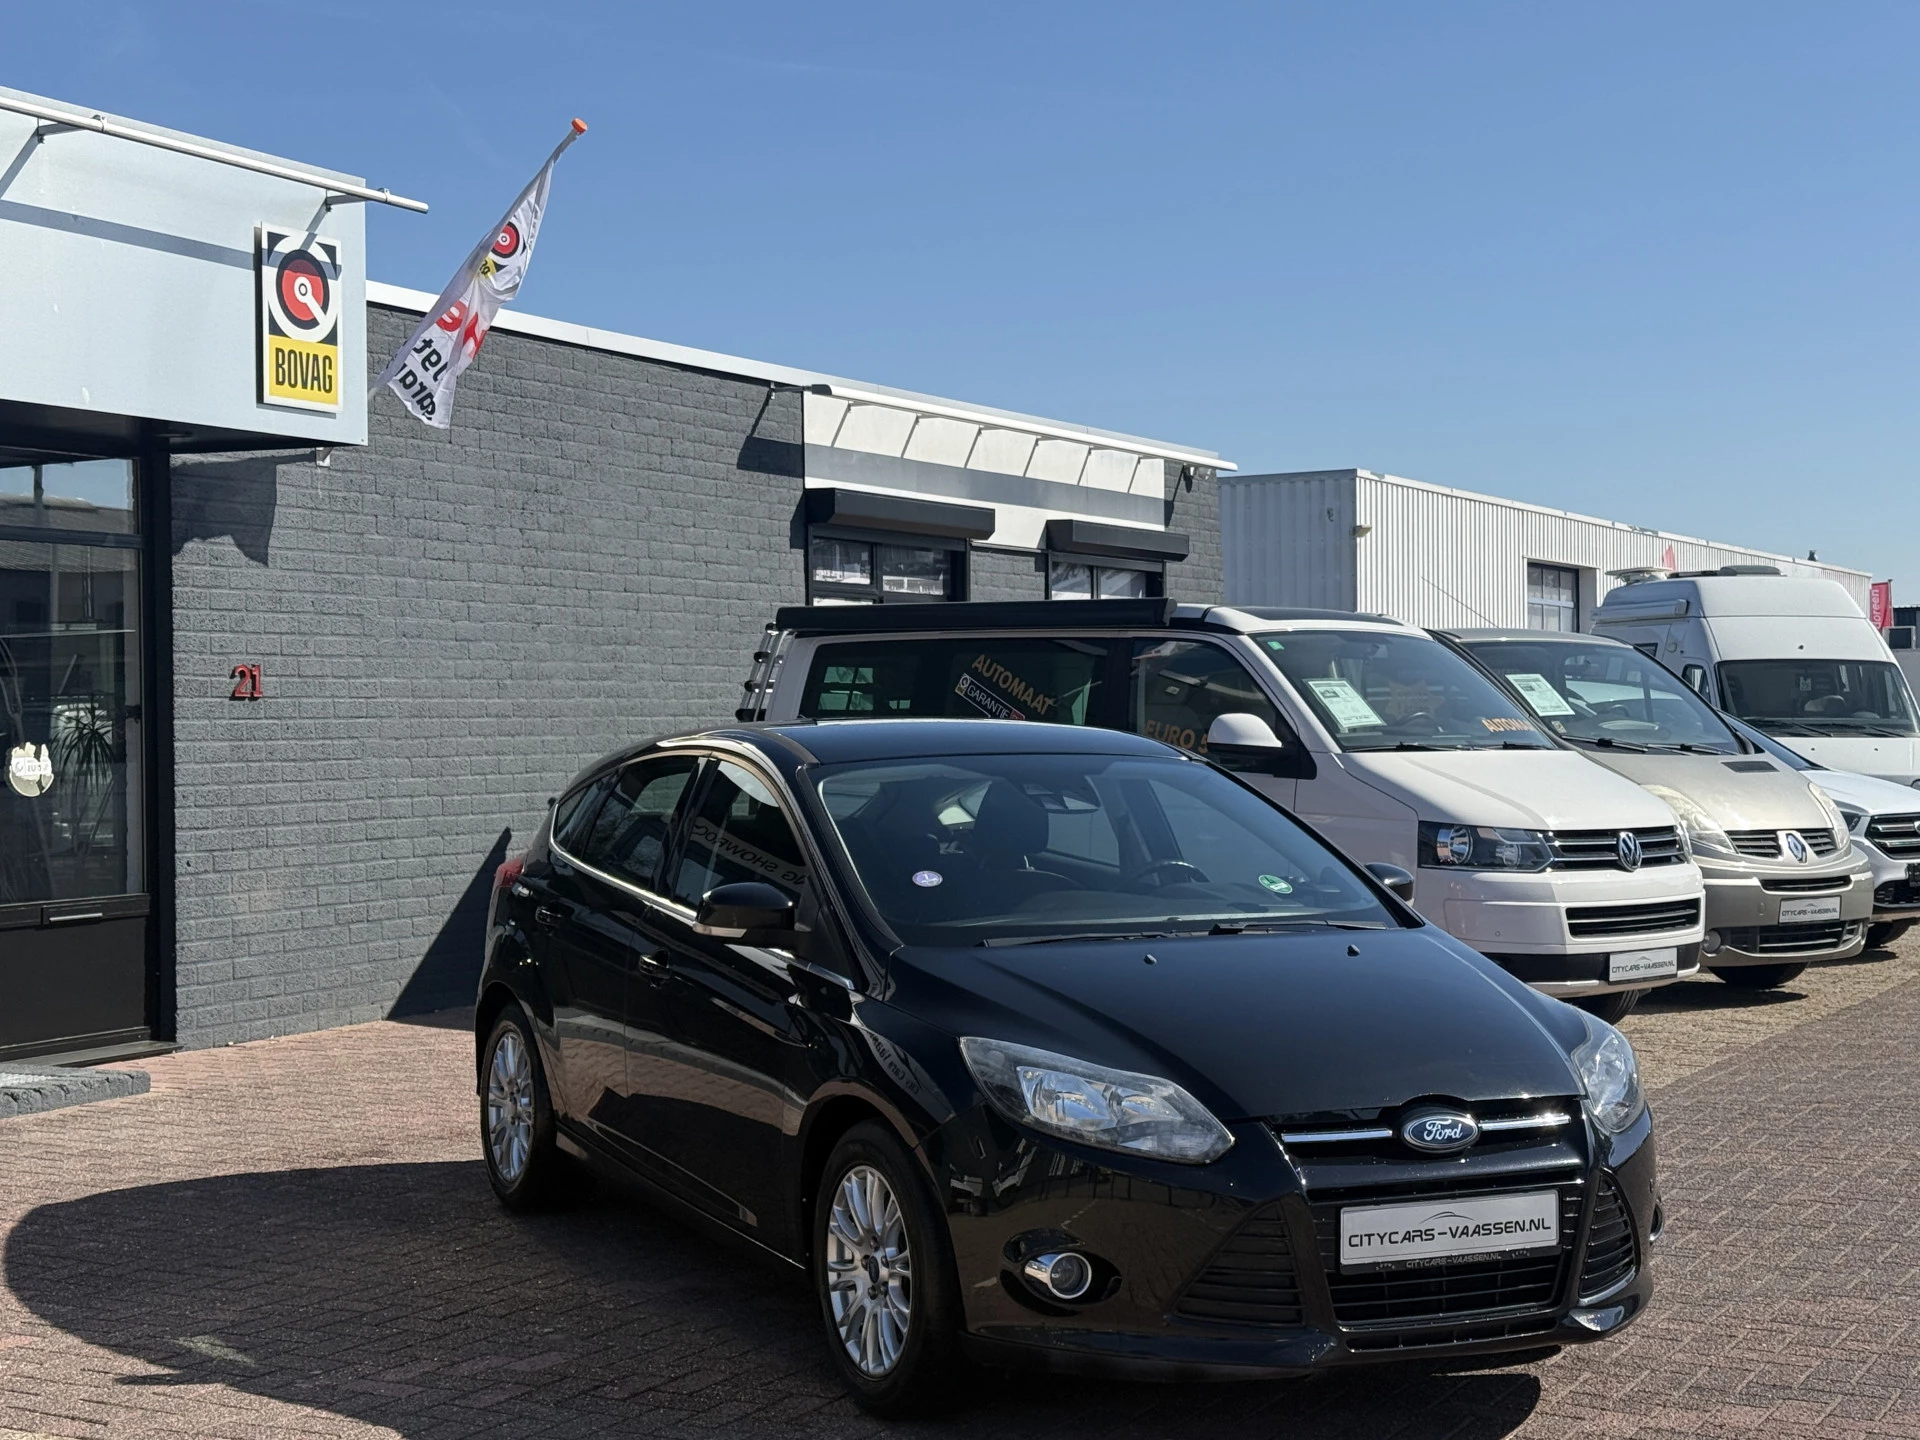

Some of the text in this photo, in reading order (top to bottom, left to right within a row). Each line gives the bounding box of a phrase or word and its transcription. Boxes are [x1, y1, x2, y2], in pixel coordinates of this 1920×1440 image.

[275, 347, 333, 394] BOVAG
[234, 664, 263, 697] 21
[971, 654, 1057, 715] AUTOMAAT
[966, 685, 1010, 719] GARANTIE
[1145, 719, 1196, 749] EURO
[1423, 1119, 1463, 1141] Ford
[1348, 1217, 1552, 1248] CITYCARS-VAASSEN.NL
[1405, 1252, 1503, 1269] CITYCARS-VAASSEN.NL
